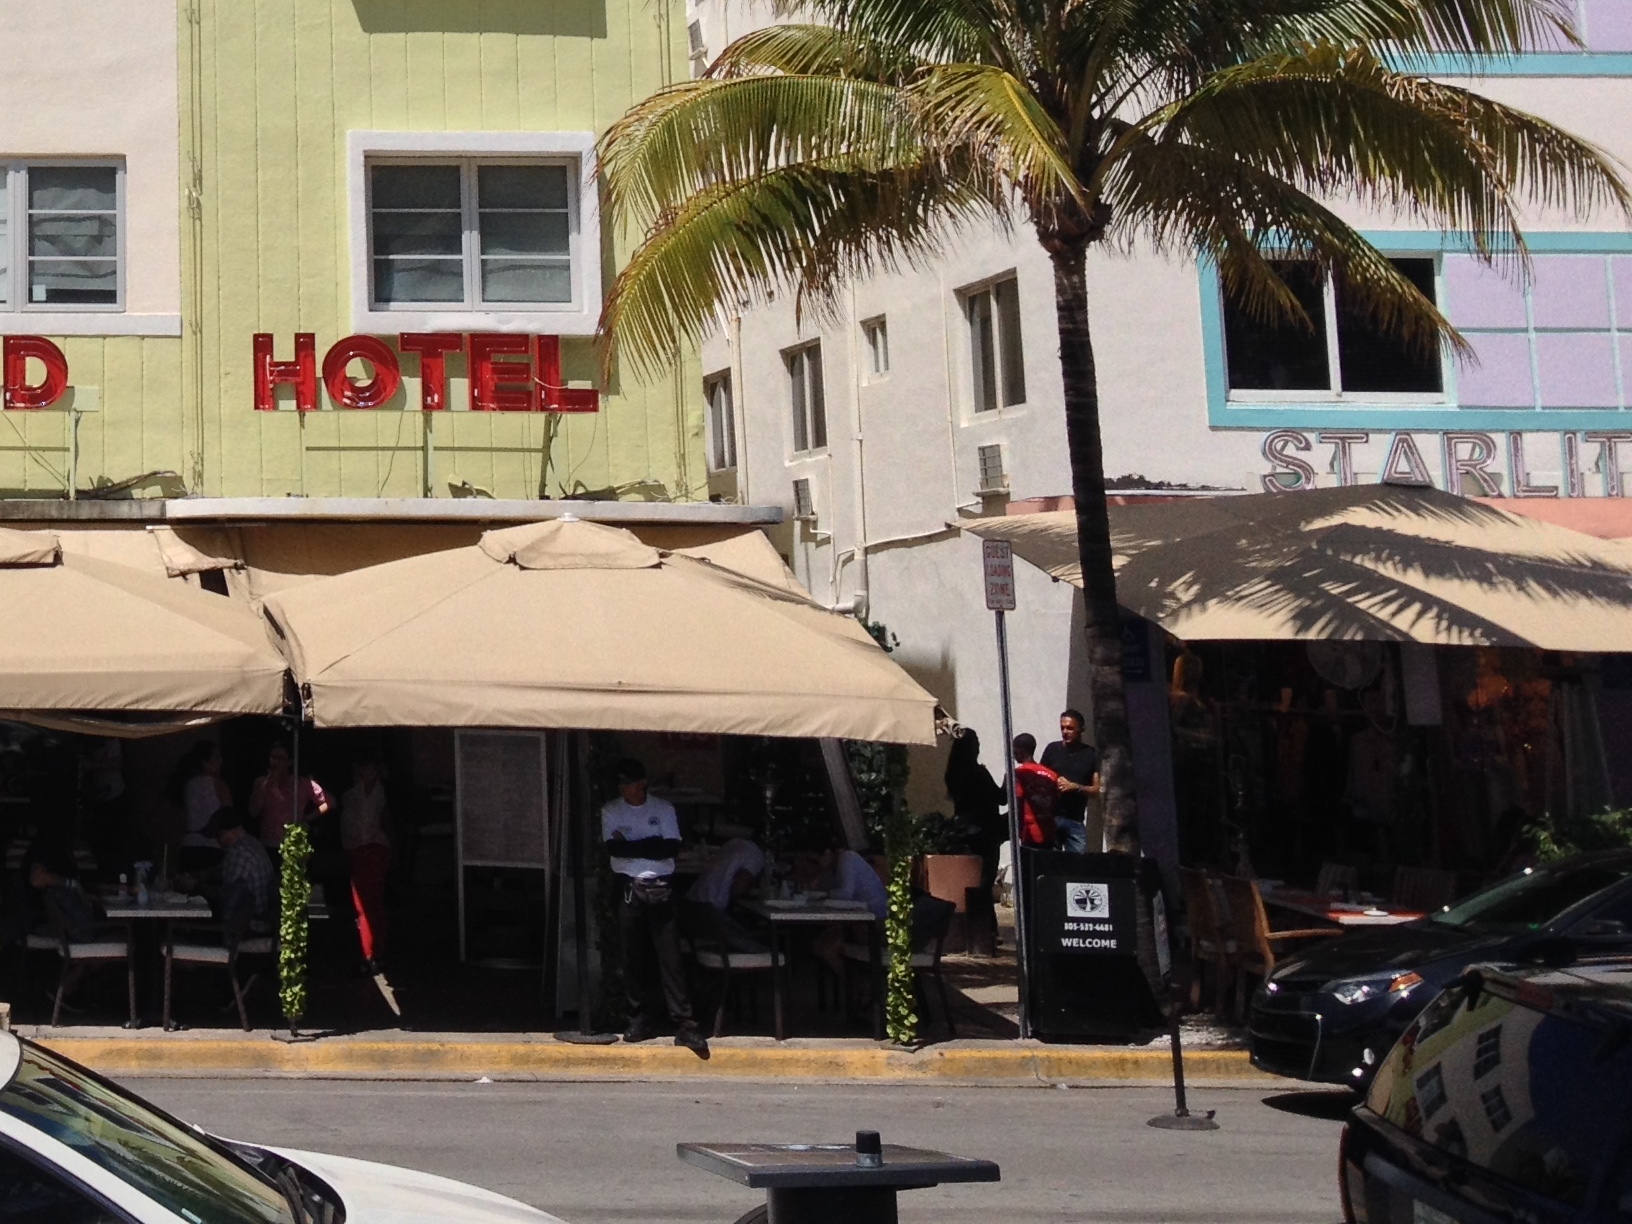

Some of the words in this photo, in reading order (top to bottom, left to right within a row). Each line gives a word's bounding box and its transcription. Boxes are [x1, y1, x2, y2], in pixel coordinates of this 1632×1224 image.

[253, 332, 599, 412] HOTEL
[1261, 429, 1632, 499] STARLIT
[1060, 937, 1117, 949] WELCOME
